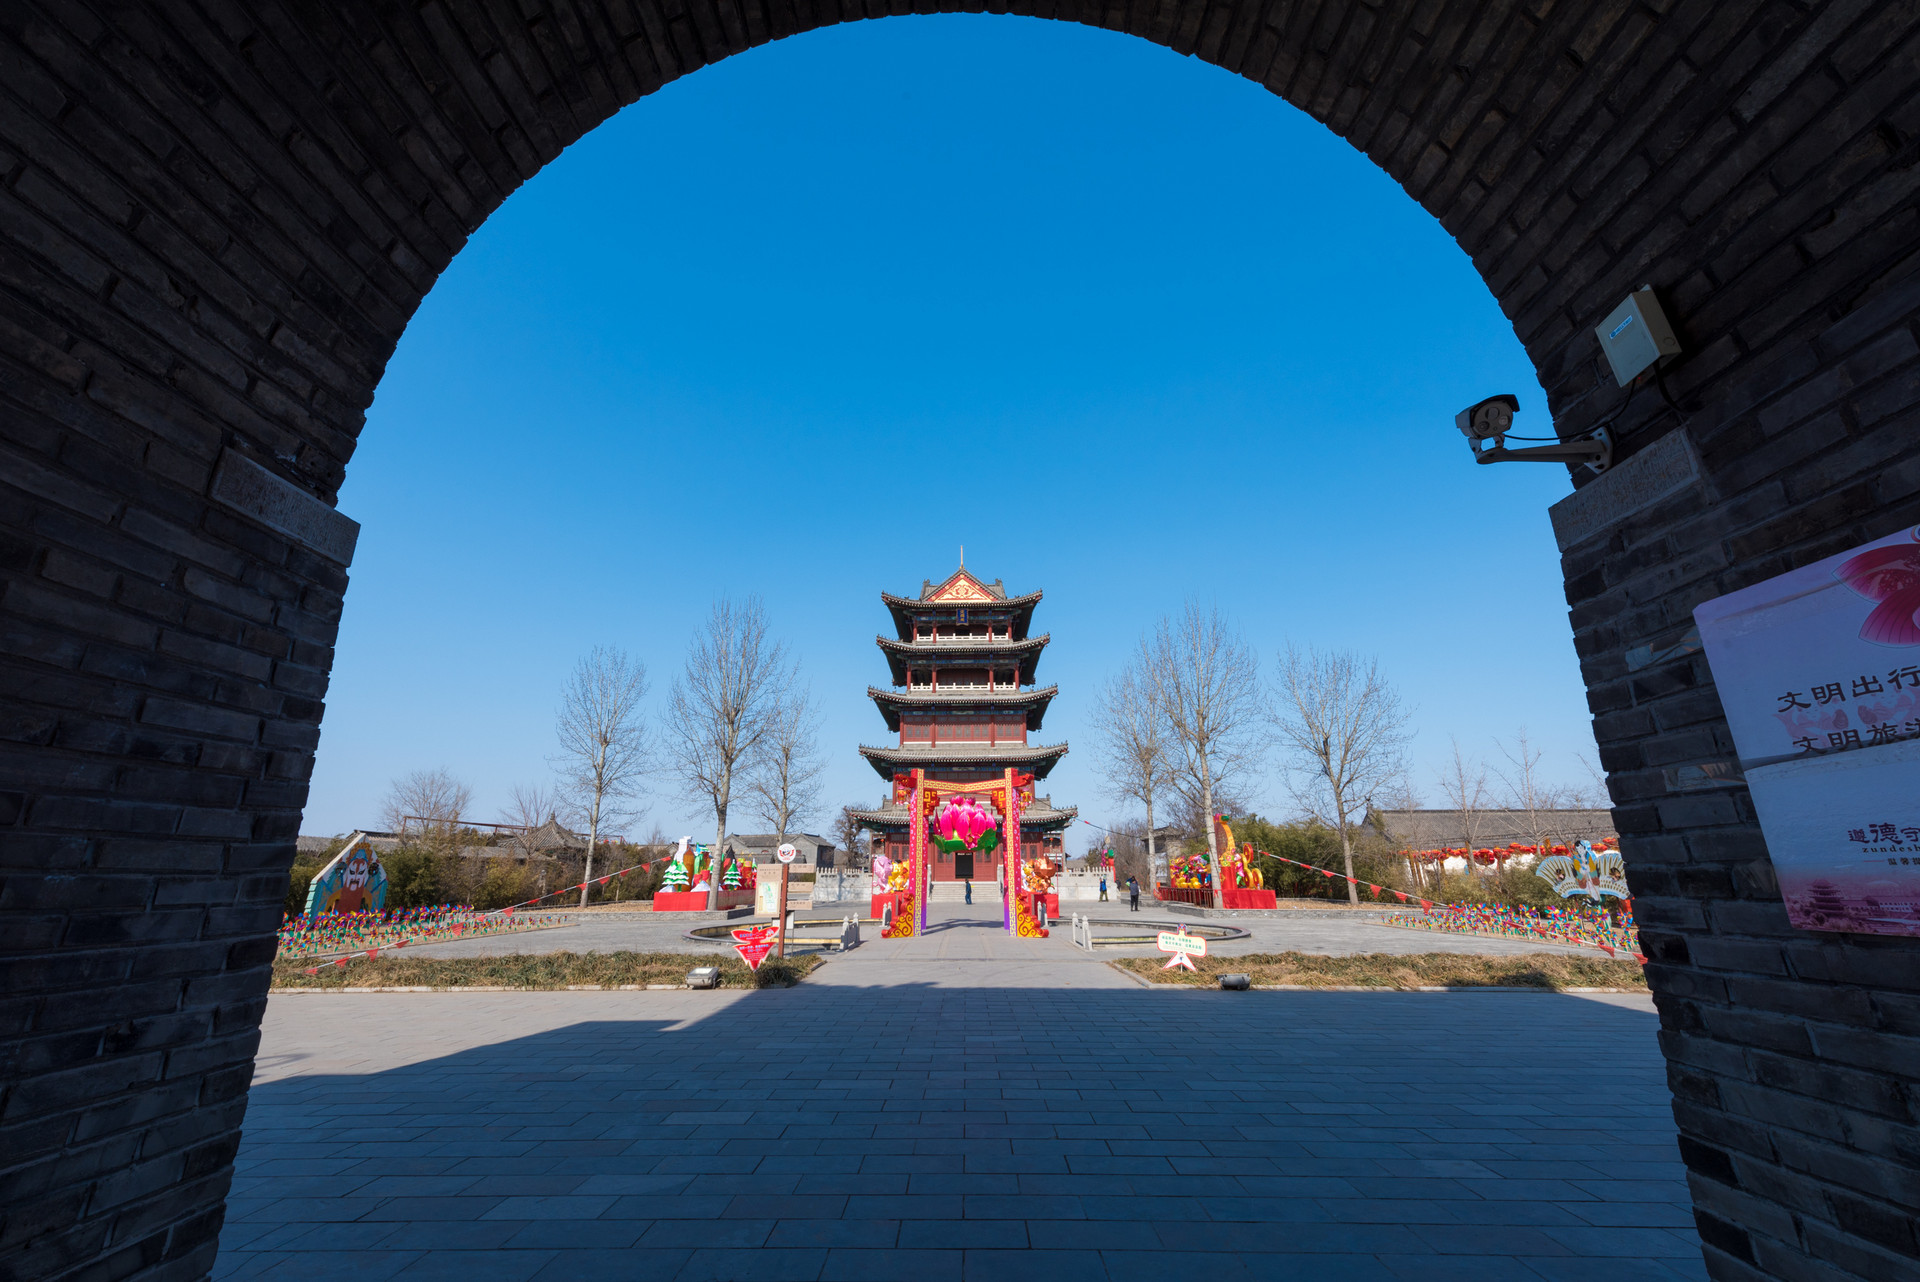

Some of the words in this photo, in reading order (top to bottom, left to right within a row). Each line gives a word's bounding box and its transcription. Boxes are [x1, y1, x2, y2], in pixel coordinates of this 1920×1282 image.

[1777, 665, 1920, 713] 文明出行
[1847, 822, 1920, 845] 遵德守
